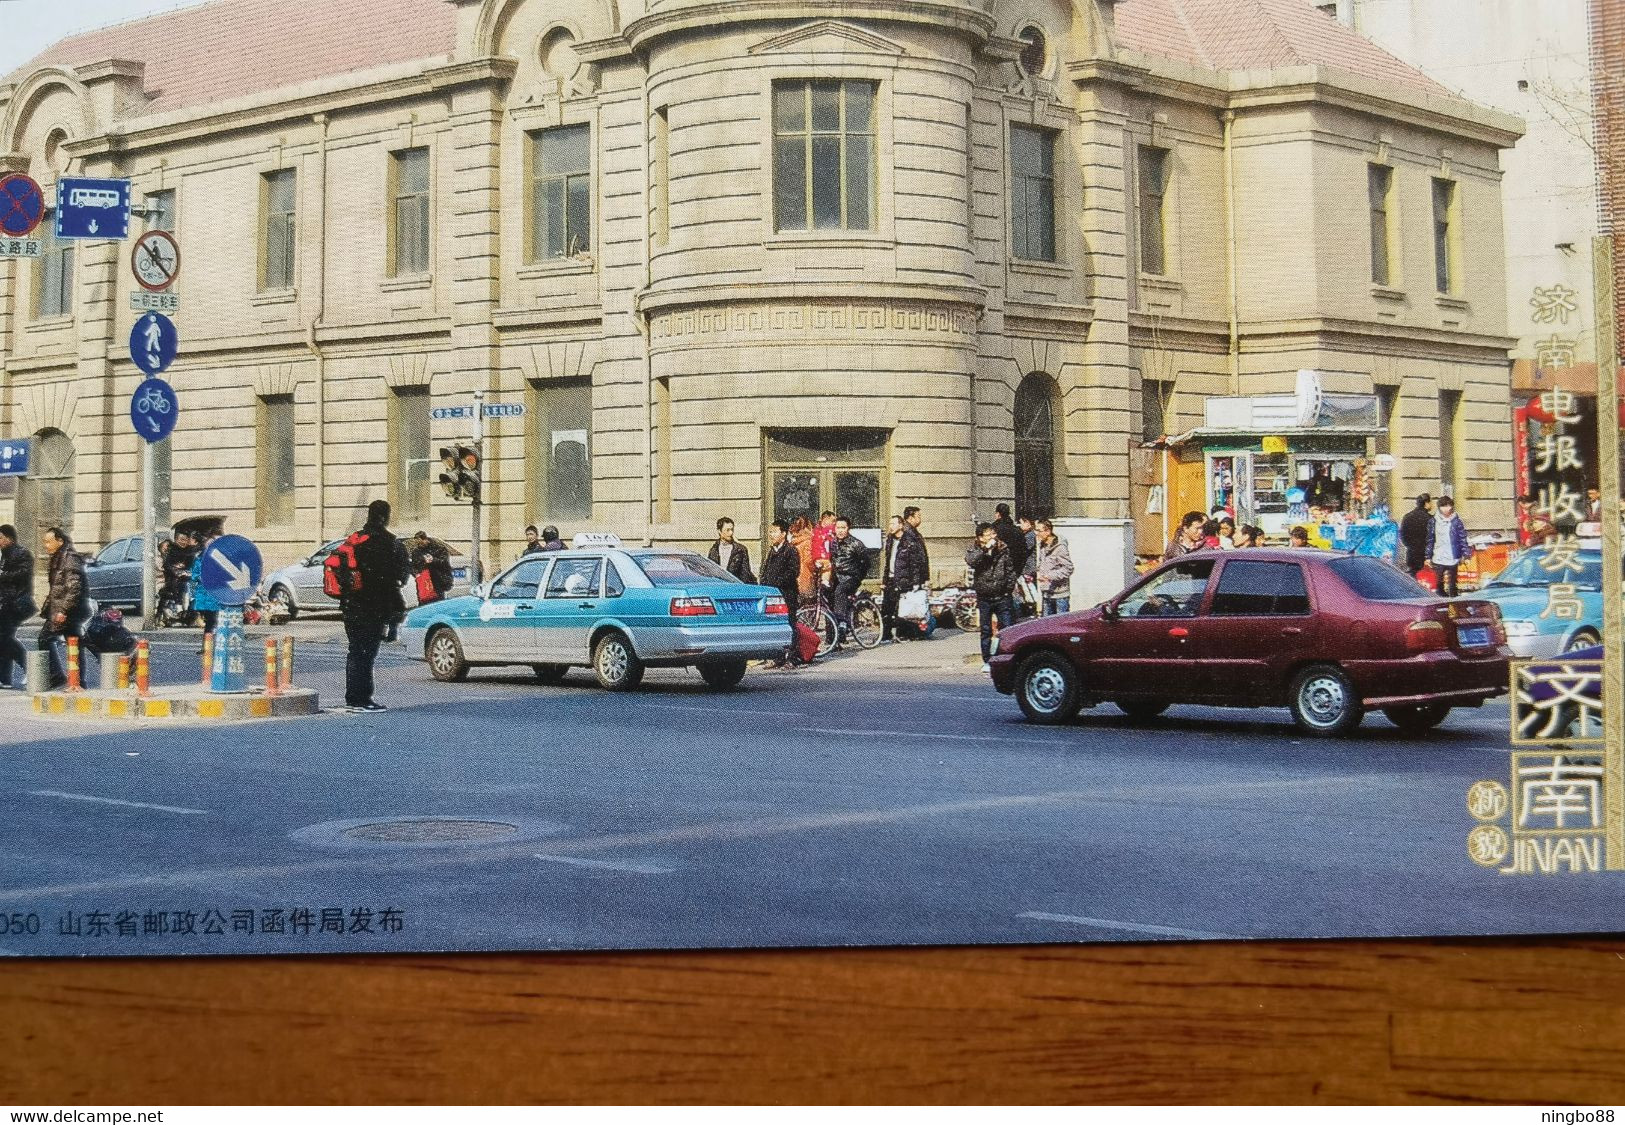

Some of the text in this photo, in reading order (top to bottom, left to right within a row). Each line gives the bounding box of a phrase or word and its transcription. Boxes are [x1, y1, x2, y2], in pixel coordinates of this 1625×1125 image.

[1500, 838, 1600, 873] JINAN
[58, 907, 404, 937] 山东省邮政公司函件局发布
